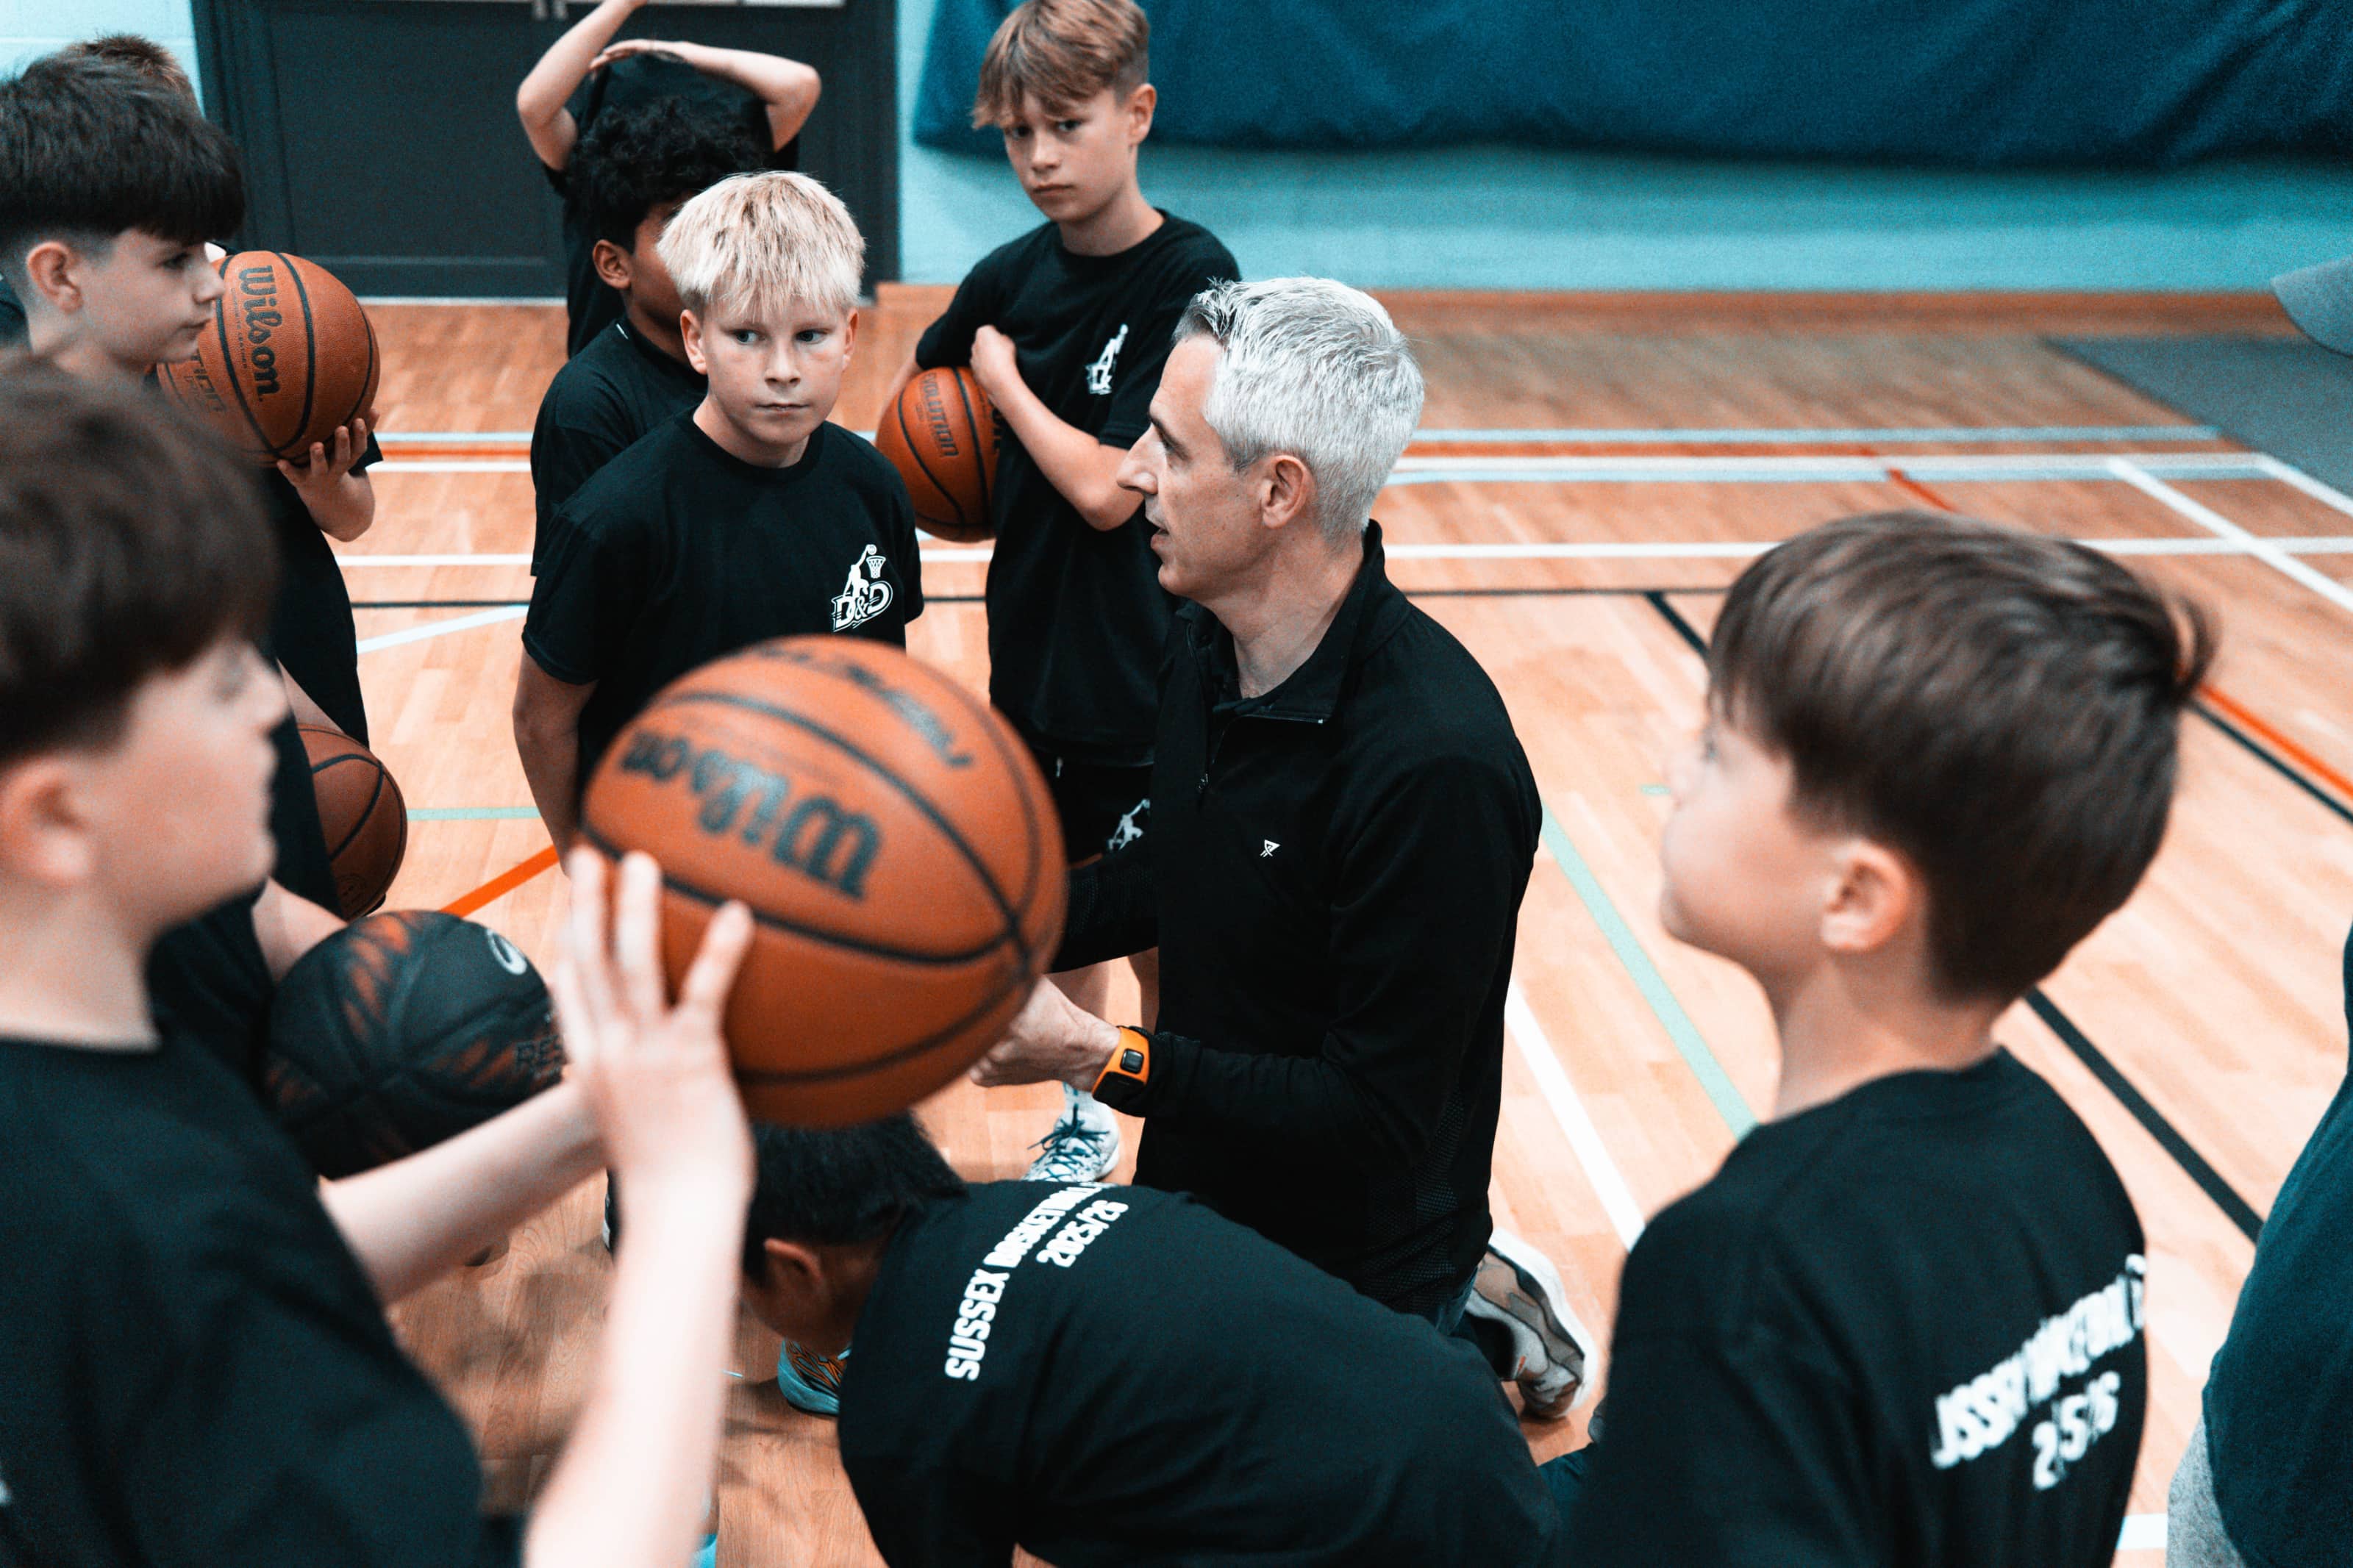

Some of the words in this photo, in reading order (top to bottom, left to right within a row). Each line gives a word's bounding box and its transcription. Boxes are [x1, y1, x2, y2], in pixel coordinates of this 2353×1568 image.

[238, 265, 282, 395] Wilson
[832, 581, 893, 631] D&D
[1035, 1200, 1129, 1267] 2025/26
[945, 1269, 1010, 1381] SUSSEX
